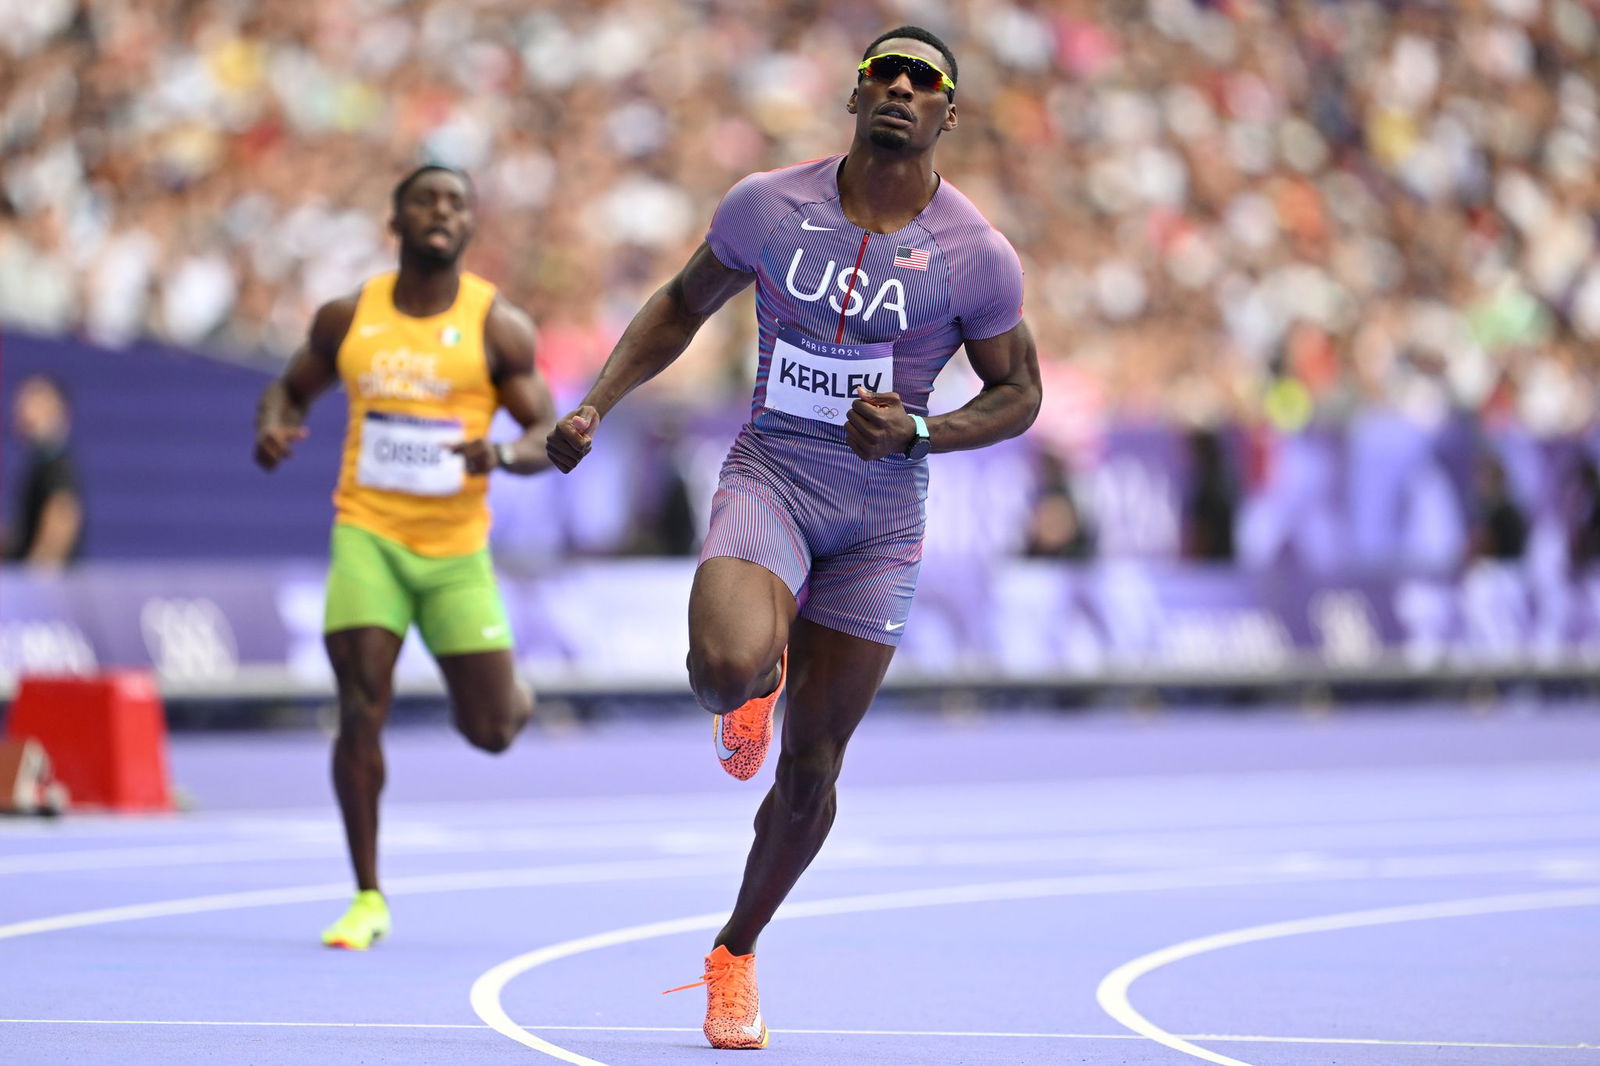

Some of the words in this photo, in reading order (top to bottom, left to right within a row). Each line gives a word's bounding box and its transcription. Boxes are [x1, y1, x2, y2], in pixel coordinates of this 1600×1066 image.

[786, 248, 907, 330] USA
[801, 338, 827, 353] PARIS
[830, 347, 860, 357] 2024
[779, 357, 883, 399] KERLEY
